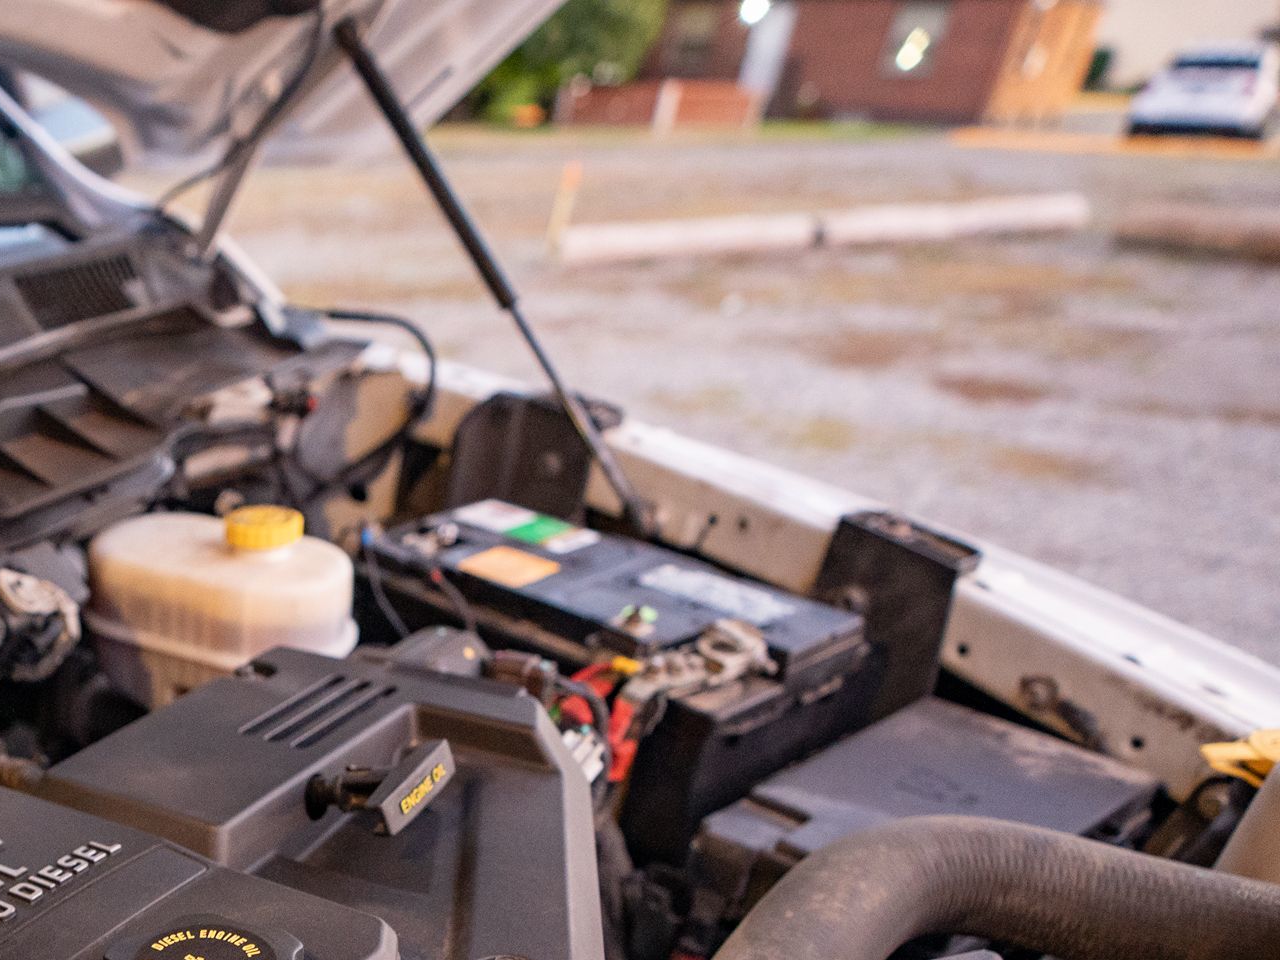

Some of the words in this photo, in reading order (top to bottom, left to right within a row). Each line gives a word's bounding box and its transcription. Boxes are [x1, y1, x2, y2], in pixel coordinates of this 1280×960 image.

[400, 774, 434, 814] ENGINE
[8, 840, 122, 904] DIESEL
[151, 930, 195, 951] DIESEL
[199, 929, 248, 947] ENGINE
[241, 942, 261, 958] OIL
